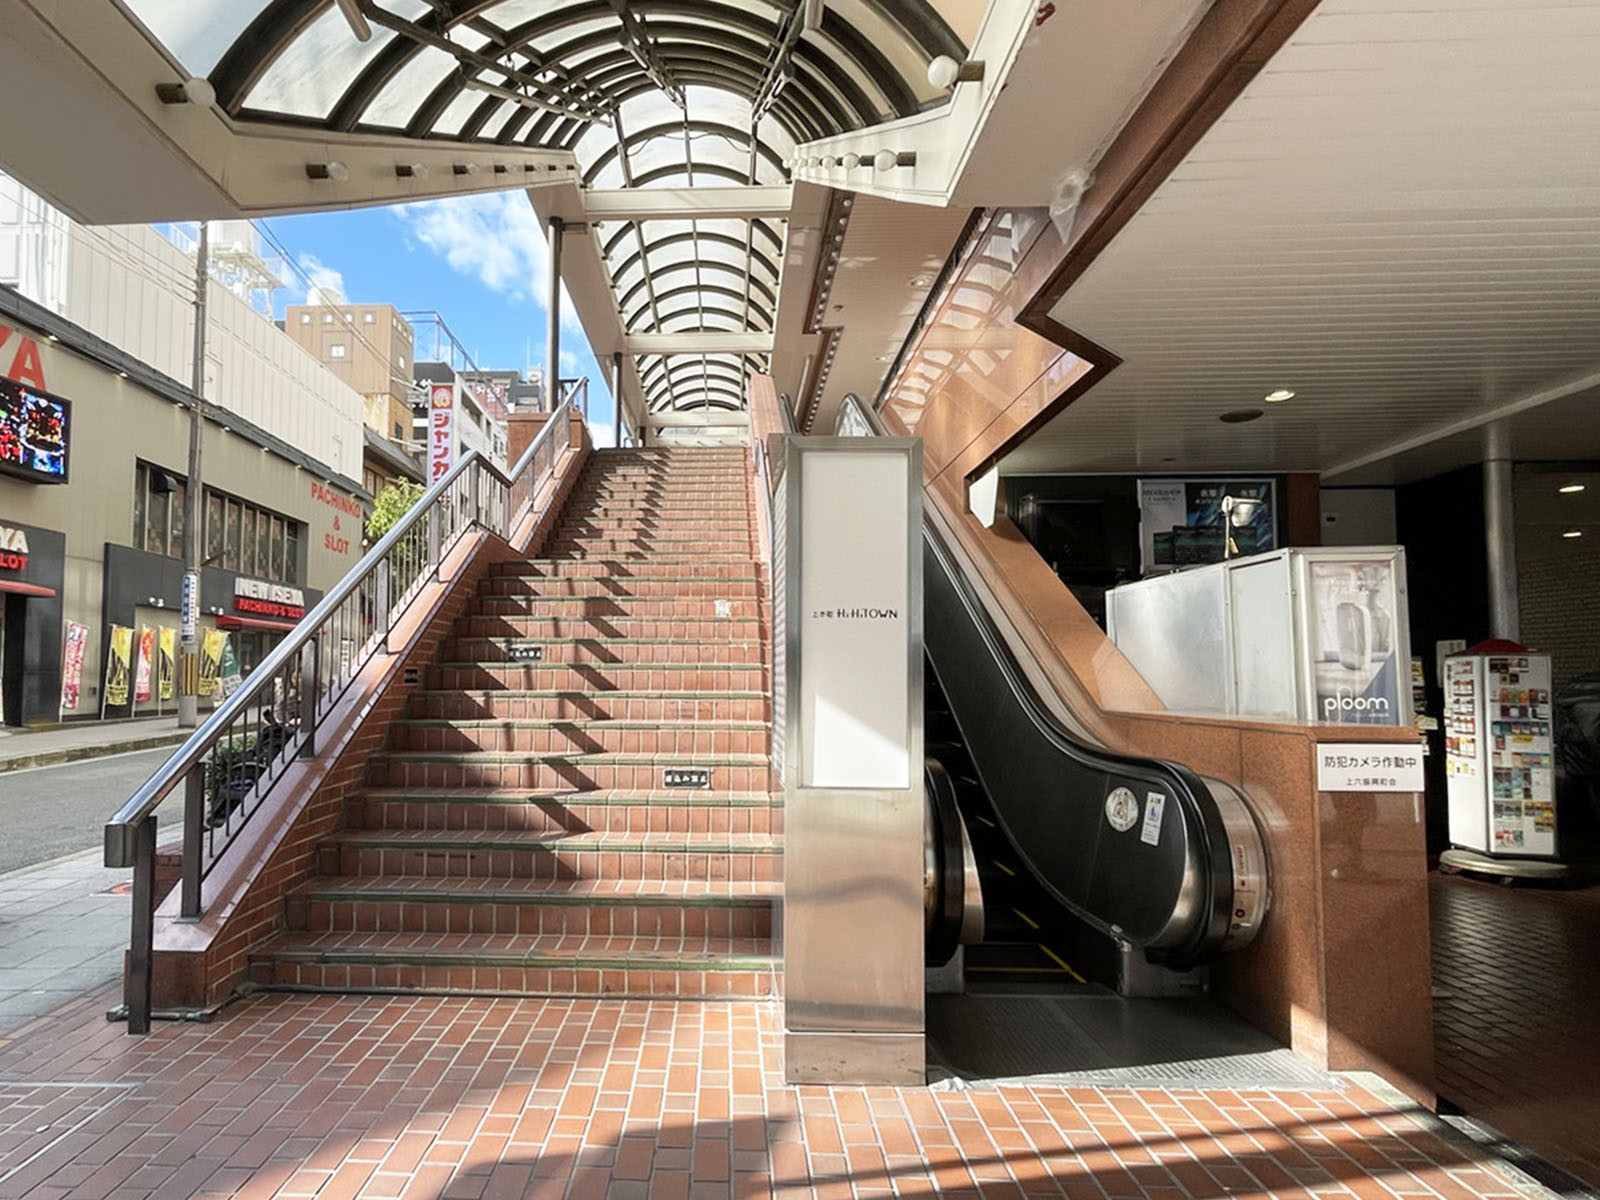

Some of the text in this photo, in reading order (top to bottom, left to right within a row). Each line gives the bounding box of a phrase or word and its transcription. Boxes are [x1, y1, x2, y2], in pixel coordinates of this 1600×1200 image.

[432, 411, 451, 484] ジャンカ
[311, 482, 361, 518] PACHINKO
[333, 515, 340, 531] &
[324, 533, 349, 555] SLOT
[1324, 689, 1389, 717] ploom
[1324, 756, 1417, 769] 防犯カメラ作動中
